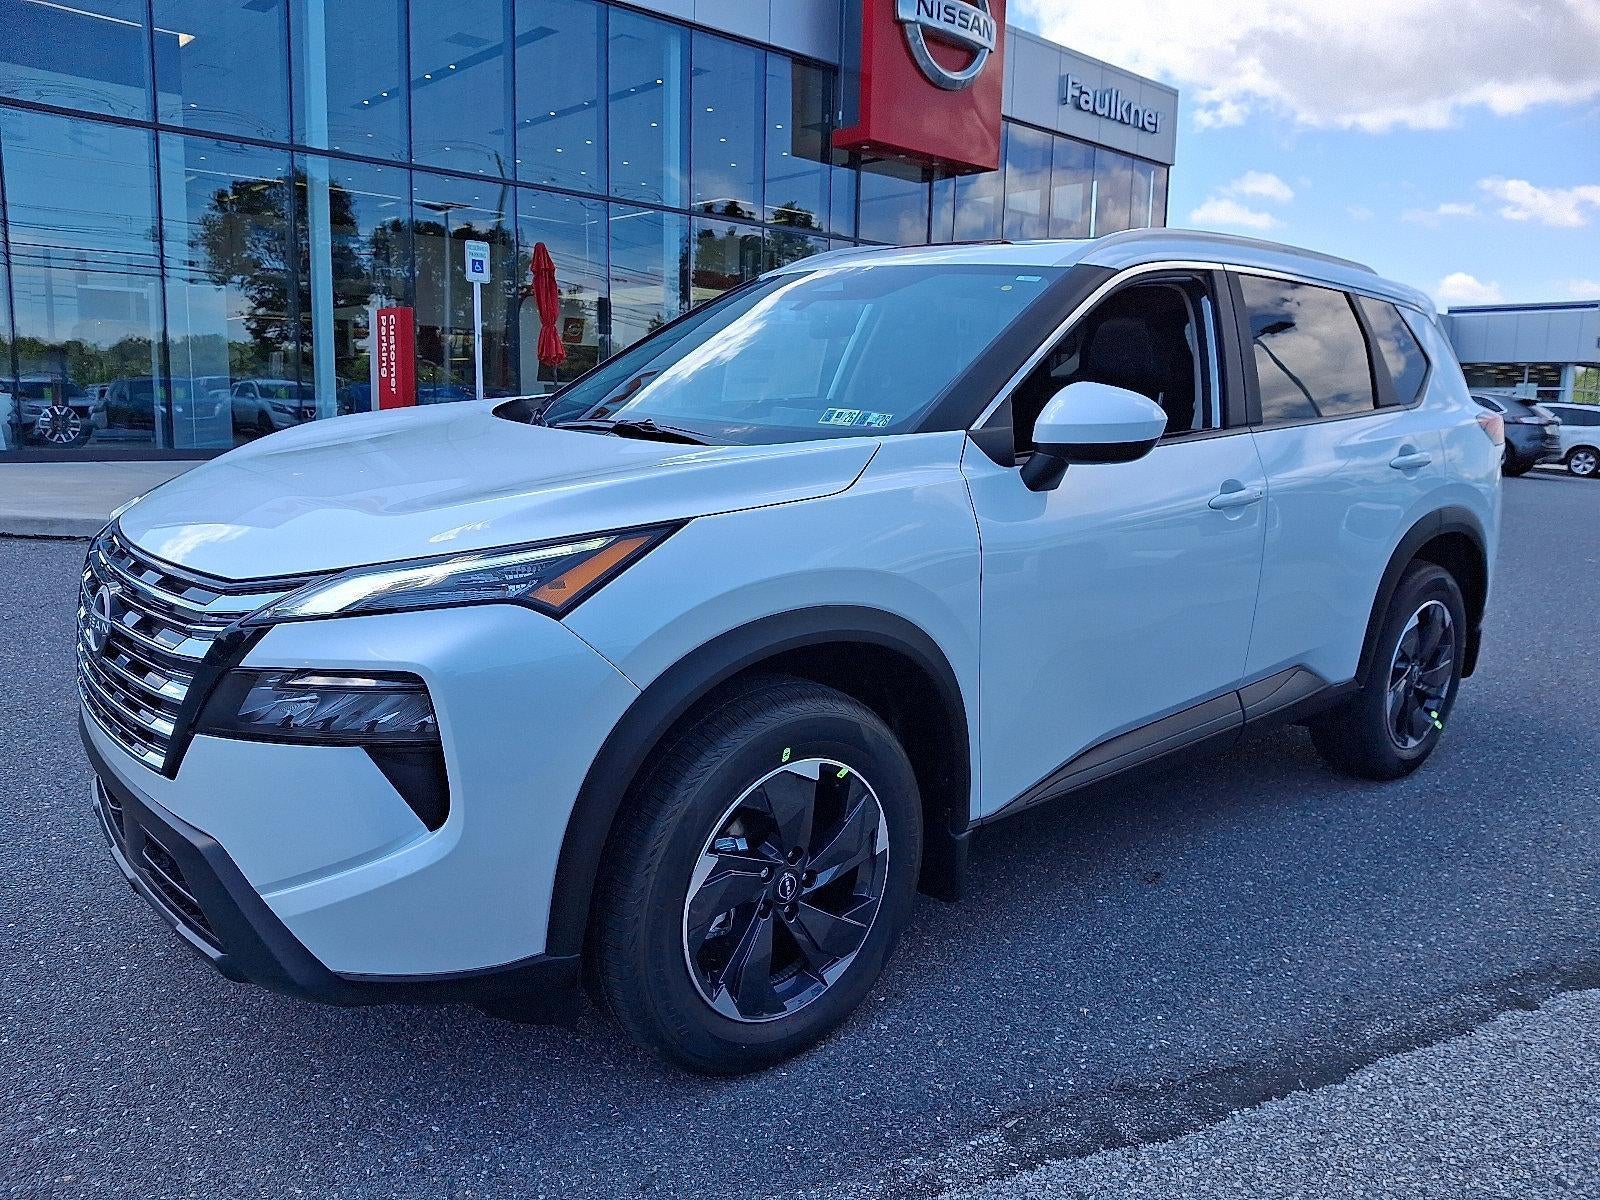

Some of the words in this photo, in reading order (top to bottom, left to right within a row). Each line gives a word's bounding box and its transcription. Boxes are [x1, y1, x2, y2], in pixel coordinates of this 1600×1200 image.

[917, 0, 993, 42] NISSAN
[1061, 73, 1160, 133] Faulkner
[380, 315, 388, 378] Parking
